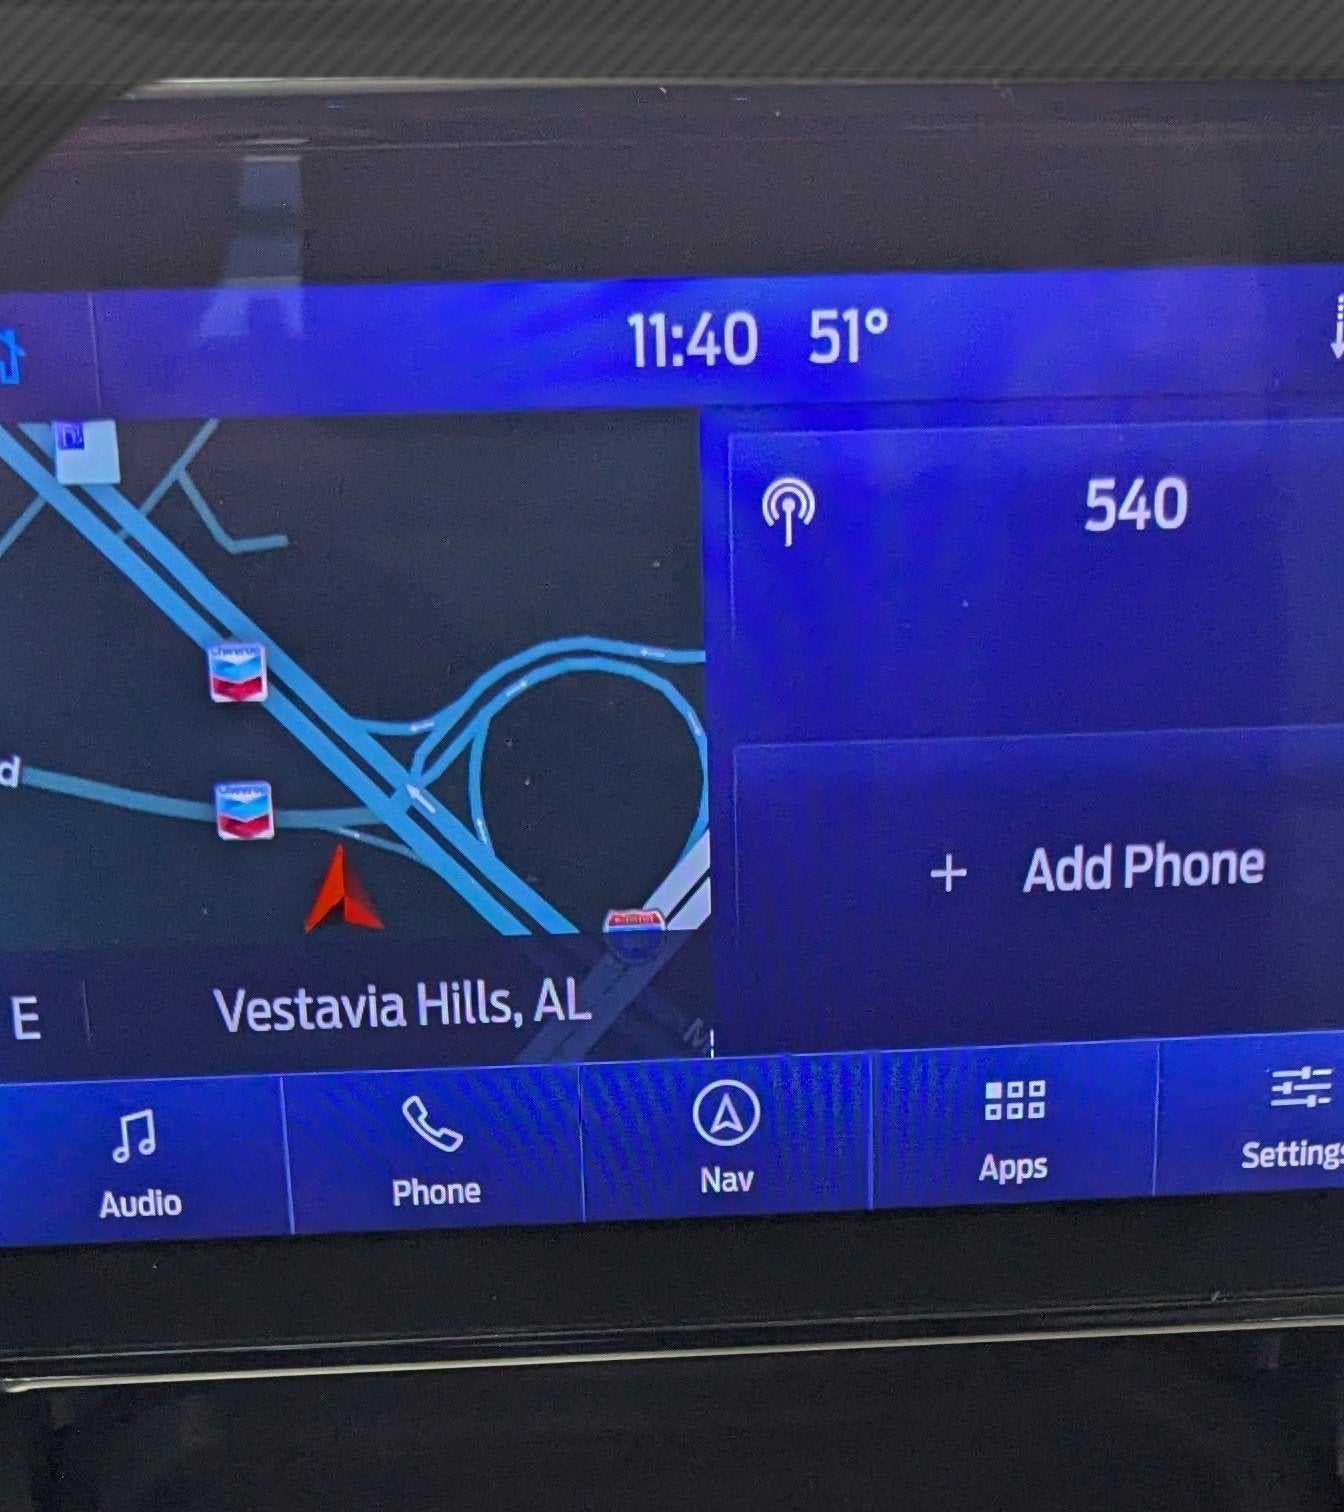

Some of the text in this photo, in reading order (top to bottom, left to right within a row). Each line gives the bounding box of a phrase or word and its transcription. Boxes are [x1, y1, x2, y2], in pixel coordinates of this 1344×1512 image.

[627, 308, 890, 369] 11:40 51°
[1084, 476, 1189, 532] 540
[1022, 841, 1266, 894] Add Phone
[10, 995, 43, 1042] E
[213, 978, 593, 1034] Vestavia Hills, AL
[392, 1176, 482, 1208] Phone
[700, 1166, 755, 1196] Nav
[978, 1152, 1049, 1186] Apps
[98, 1187, 183, 1221] Audio
